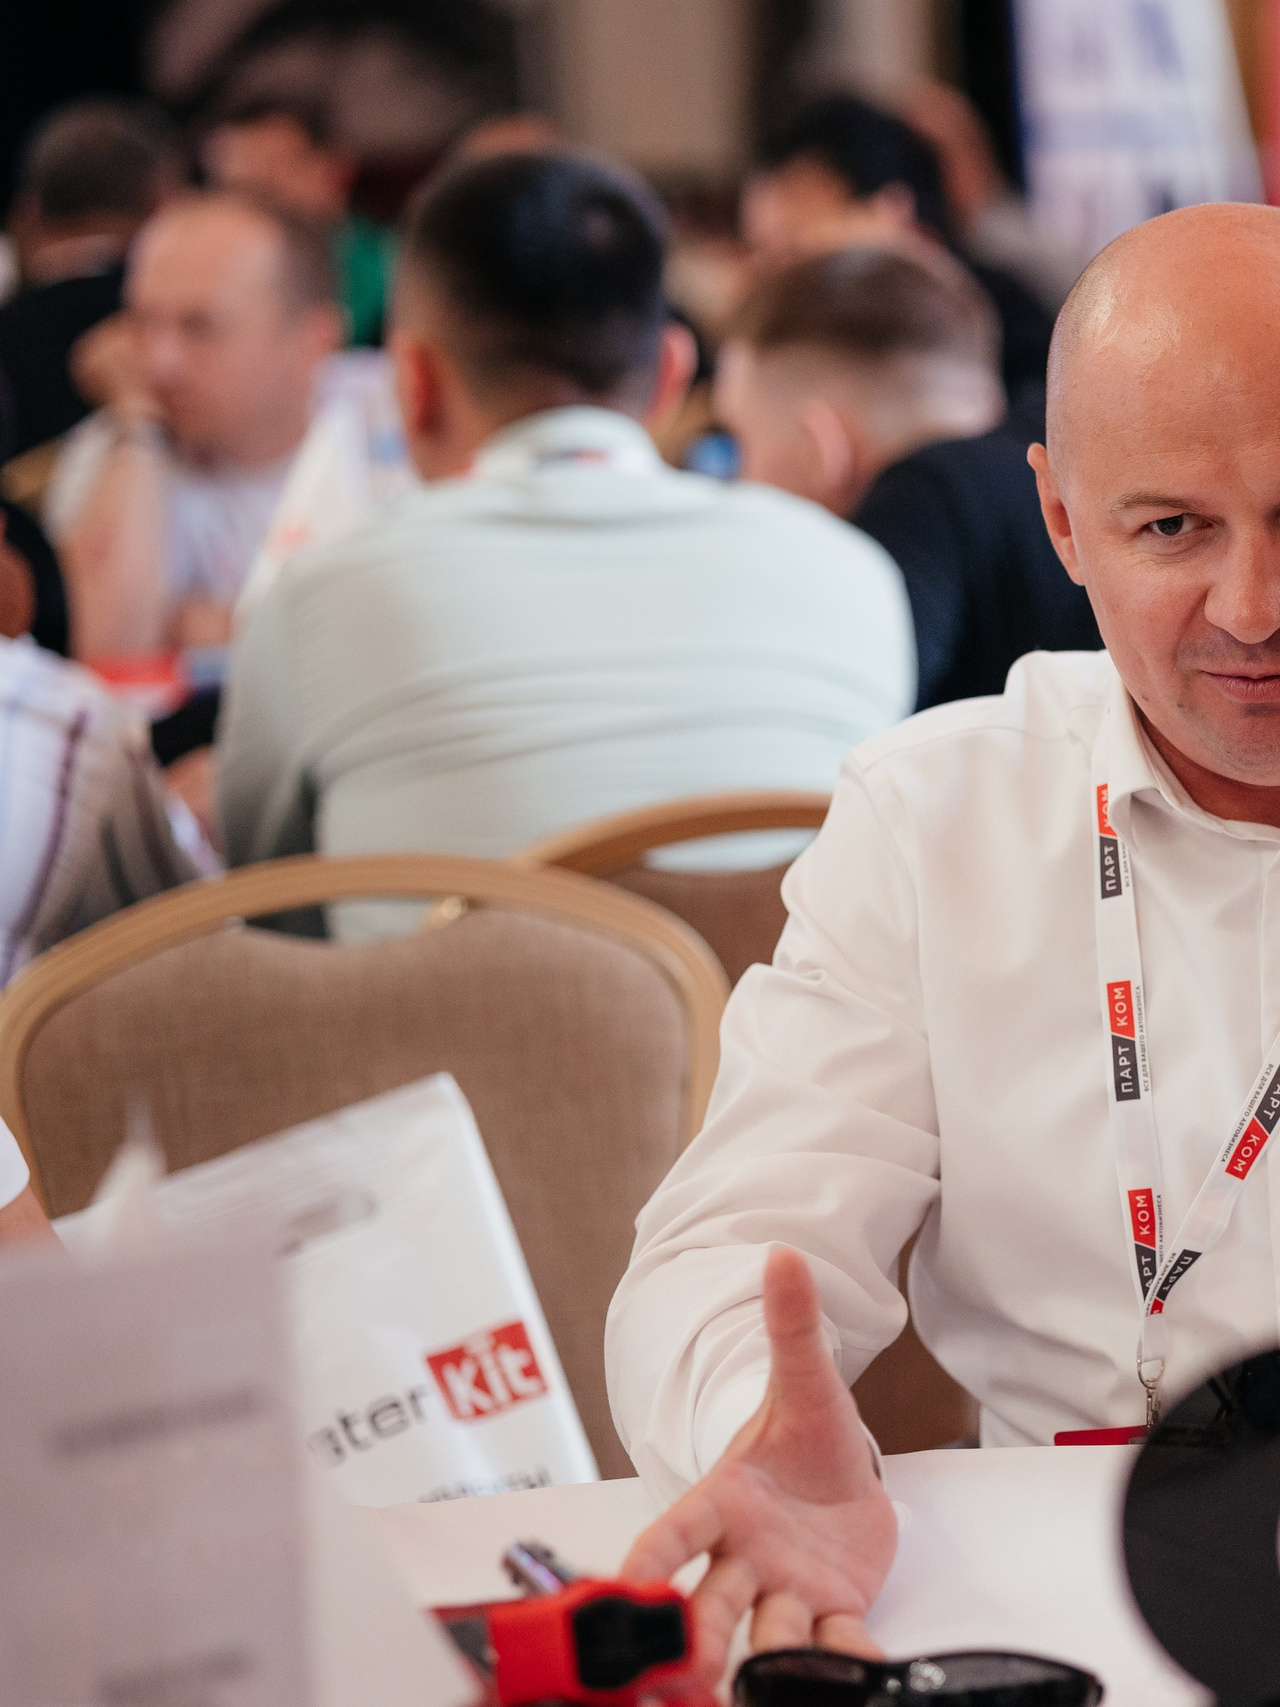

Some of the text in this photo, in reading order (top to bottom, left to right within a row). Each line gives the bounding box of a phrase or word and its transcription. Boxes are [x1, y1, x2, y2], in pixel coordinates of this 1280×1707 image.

[1104, 845, 1117, 891] ПАРТ
[1135, 986, 1145, 1033] АВТОБИЗНЕСА
[1113, 986, 1134, 1093] ПАРТ КОМ
[1139, 1035, 1149, 1063] ВАШЕГО
[1219, 1063, 1275, 1163] ВСЕ ДЛЯ ВАШЕГО АВТОБИЗНЕСА
[1233, 1134, 1260, 1173] КОМ
[1133, 1194, 1150, 1236] КОМ
[1156, 1193, 1165, 1244] АВТОБИЗНЕСА
[1141, 1255, 1153, 1289] АРТ
[1167, 1252, 1177, 1263] ВСЕ
[440, 1337, 541, 1418] kit
